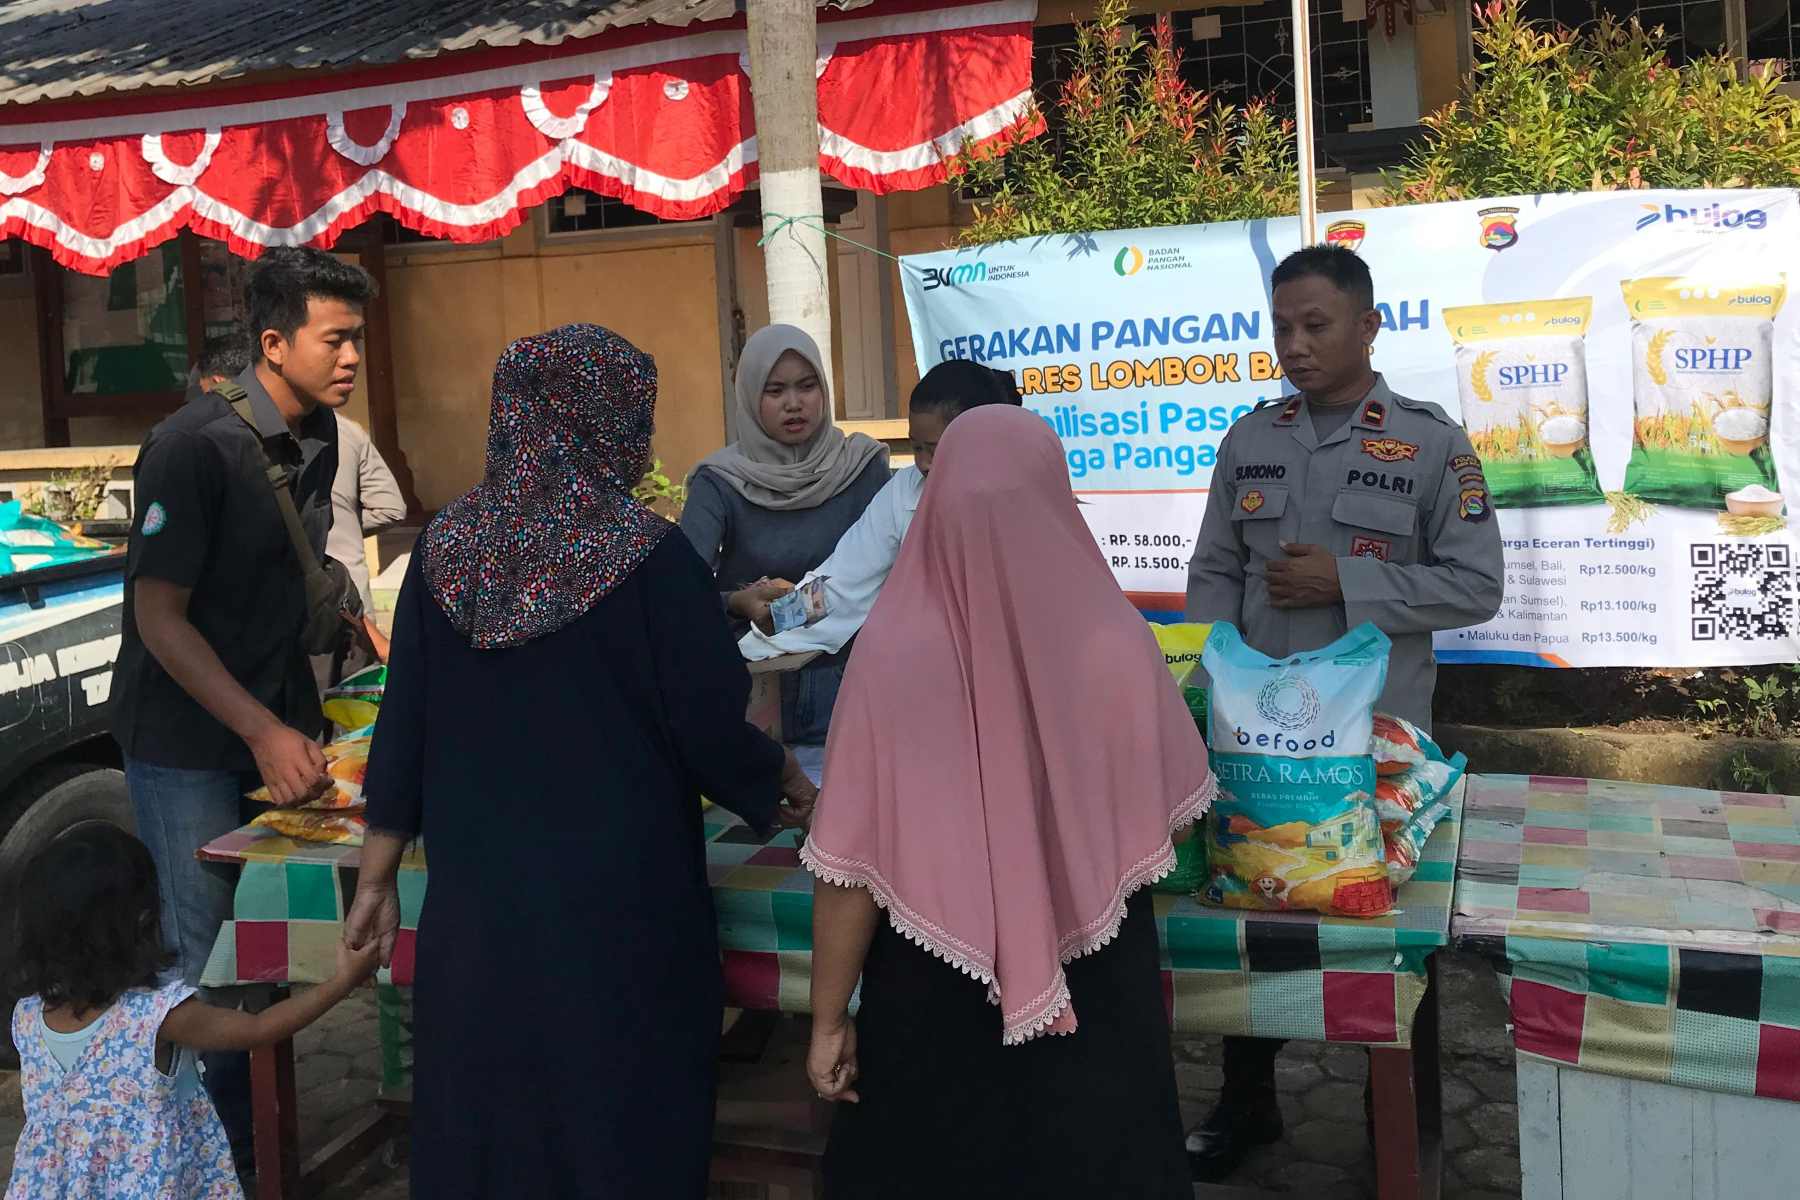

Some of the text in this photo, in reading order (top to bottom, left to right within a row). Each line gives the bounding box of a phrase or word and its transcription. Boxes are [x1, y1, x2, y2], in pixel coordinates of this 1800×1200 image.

[1148, 247, 1180, 256] BADAN
[1146, 262, 1192, 271] NASIONAL
[1148, 255, 1185, 264] PANGAN
[987, 270, 1030, 281] INDONESIA
[988, 265, 1016, 274] UNTUK
[1737, 295, 1772, 305] bulog
[939, 299, 1430, 363] GERAKAN PANGAN AH
[1675, 348, 1752, 370] SPHP
[1010, 363, 1083, 396] RES
[1090, 353, 1241, 391] LOMBOK
[1498, 363, 1569, 386] SPHP
[1113, 441, 1216, 476] Panga
[1346, 469, 1414, 494] POLRI
[1110, 534, 1131, 546] RP.
[1134, 534, 1192, 548] 58.000,-
[1502, 537, 1655, 551] arga Eceran Tertinggi)
[1112, 556, 1131, 568] RP.
[1504, 560, 1656, 577] umsel, Bali, Rp12.500/kg
[1507, 574, 1567, 586] & Sulawesi
[1503, 596, 1517, 605] an
[1580, 600, 1656, 614] Rp13.100/kg
[1508, 609, 1568, 621] Kalimantan
[1467, 630, 1657, 645] Maluku dan Papua Rp13.500/kg
[1165, 653, 1203, 664] bulog
[1237, 726, 1335, 752] befood
[1279, 763, 1364, 785] RAMOS
